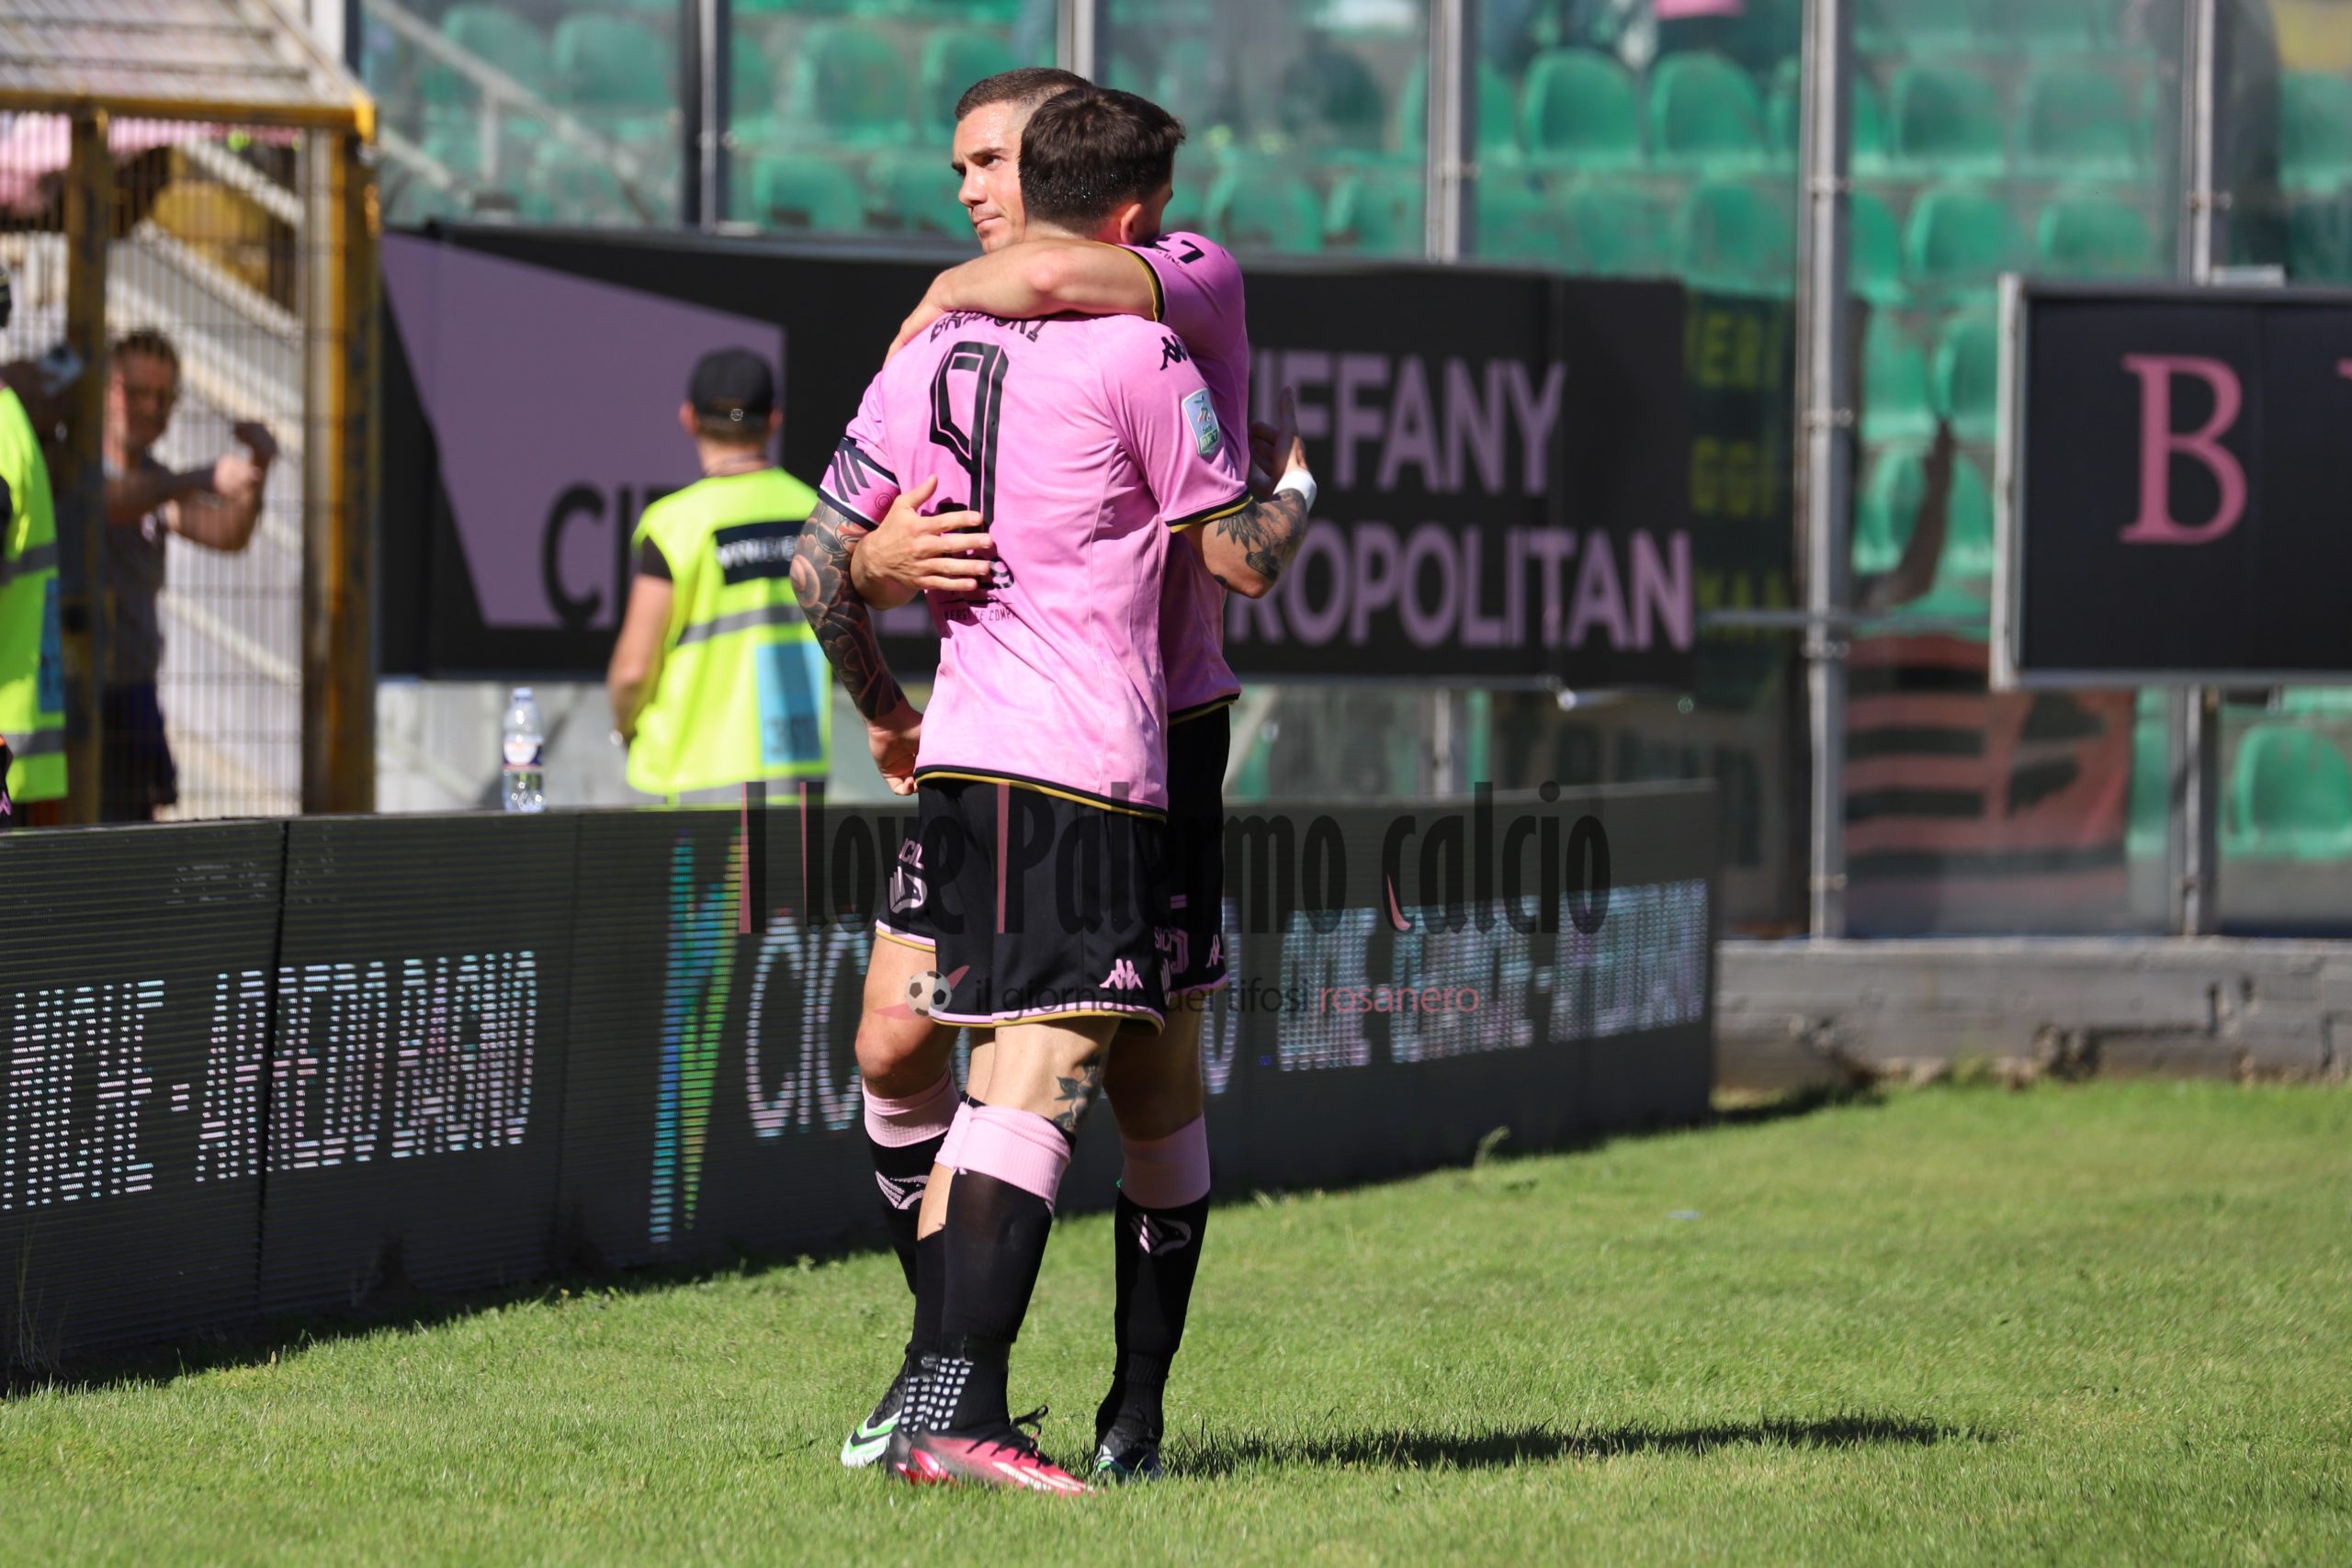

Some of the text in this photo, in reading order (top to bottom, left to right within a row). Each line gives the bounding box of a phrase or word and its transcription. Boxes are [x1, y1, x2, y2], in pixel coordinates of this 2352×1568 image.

[929, 340, 1009, 533] 9
[1250, 344, 1567, 497] IFFANY
[1229, 520, 1693, 651] ROPOLITAN
